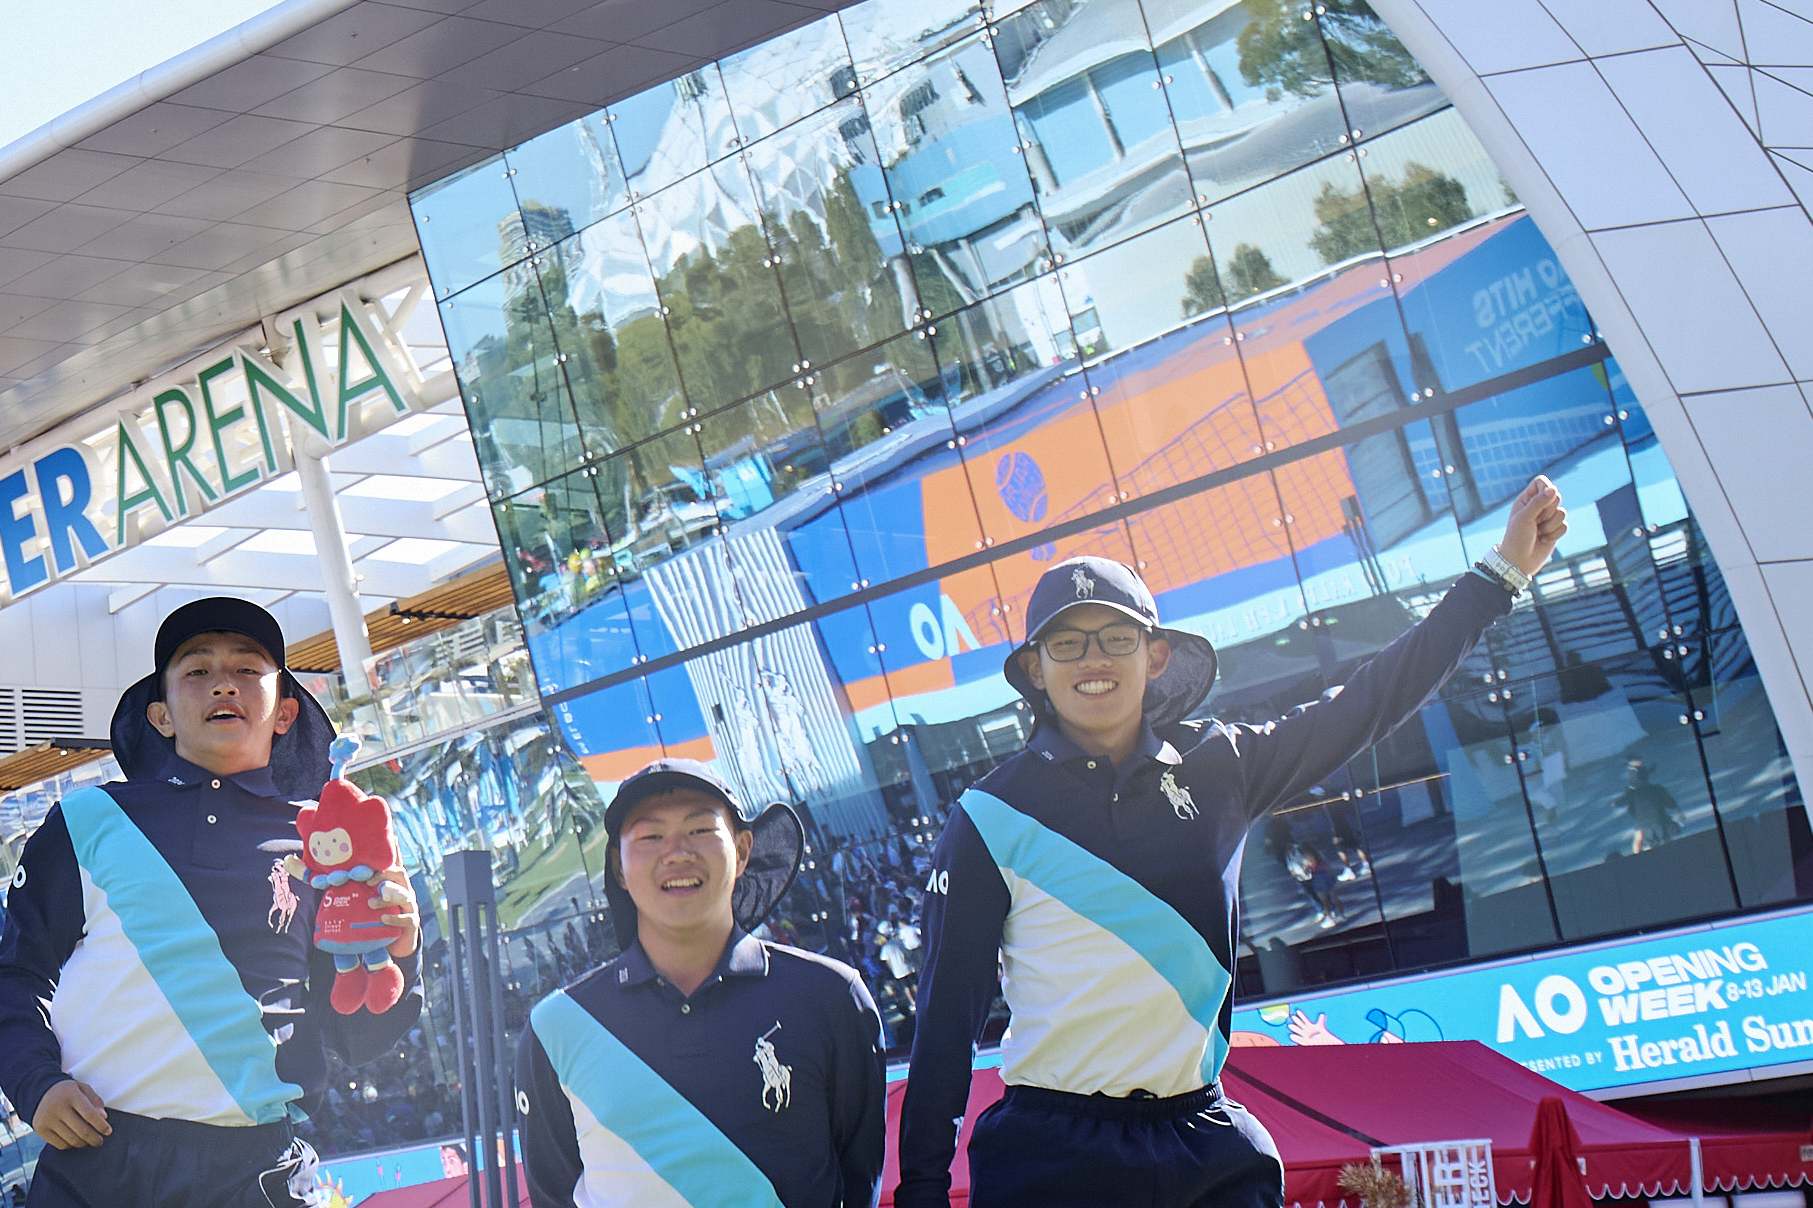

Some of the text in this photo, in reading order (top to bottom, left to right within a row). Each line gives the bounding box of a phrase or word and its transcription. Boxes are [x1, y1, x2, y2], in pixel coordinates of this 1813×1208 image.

[117, 297, 410, 546] ARENA
[13, 864, 27, 889] O
[925, 868, 949, 896] AO
[1588, 942, 1769, 995] OPENING
[1497, 975, 1588, 1044] AO
[1597, 971, 1807, 1027] WEEK 8-13 JAN
[1521, 1051, 1603, 1073] SENTED BY
[1607, 1014, 1813, 1072] Herald Sun
[514, 1085, 530, 1116] O
